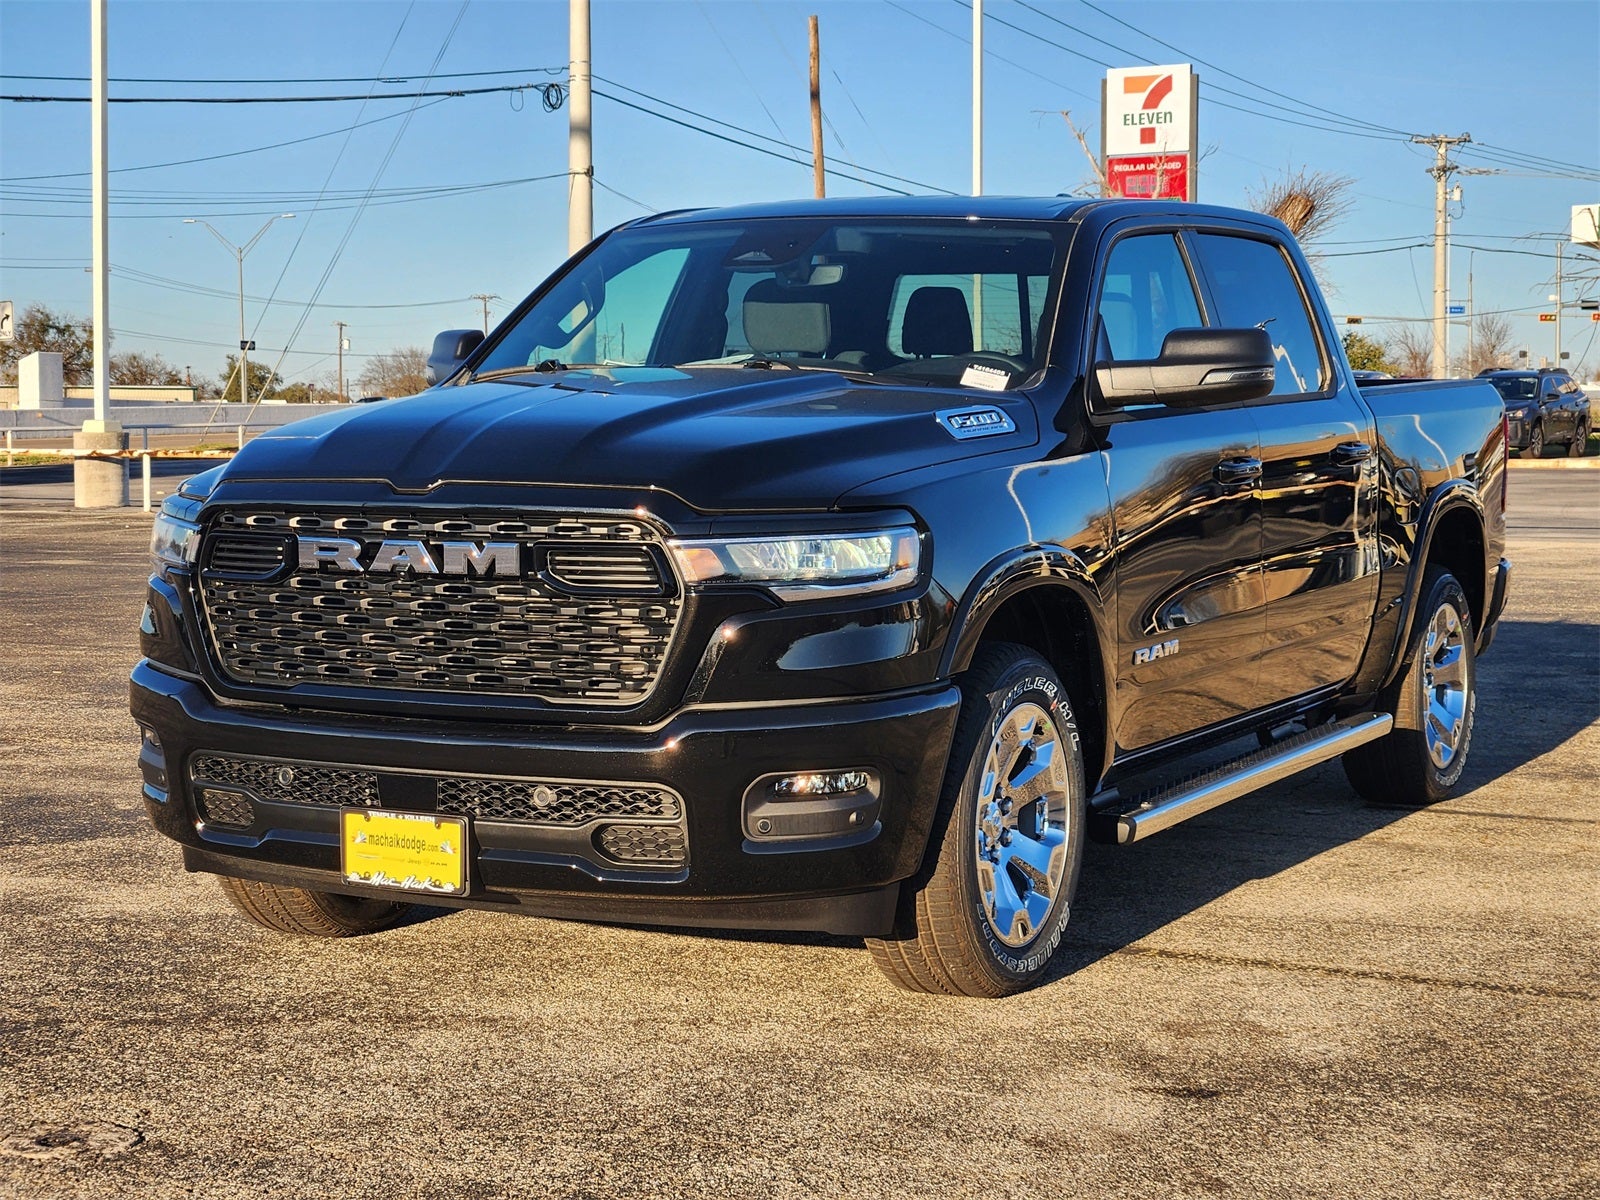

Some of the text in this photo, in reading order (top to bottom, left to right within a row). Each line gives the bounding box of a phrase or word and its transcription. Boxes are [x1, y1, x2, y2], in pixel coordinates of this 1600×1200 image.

[1124, 73, 1173, 110] 7
[1114, 161, 1182, 172] REGULAR UNADED
[949, 412, 1001, 429] 1500
[298, 536, 519, 576] RAM
[1133, 639, 1180, 665] RAM
[367, 811, 436, 823] TEMPLE KILLEEN
[368, 832, 439, 854] machaikdodge.com
[370, 871, 435, 889] Mac Haik
[976, 901, 1071, 973] BRIDGESTONE
